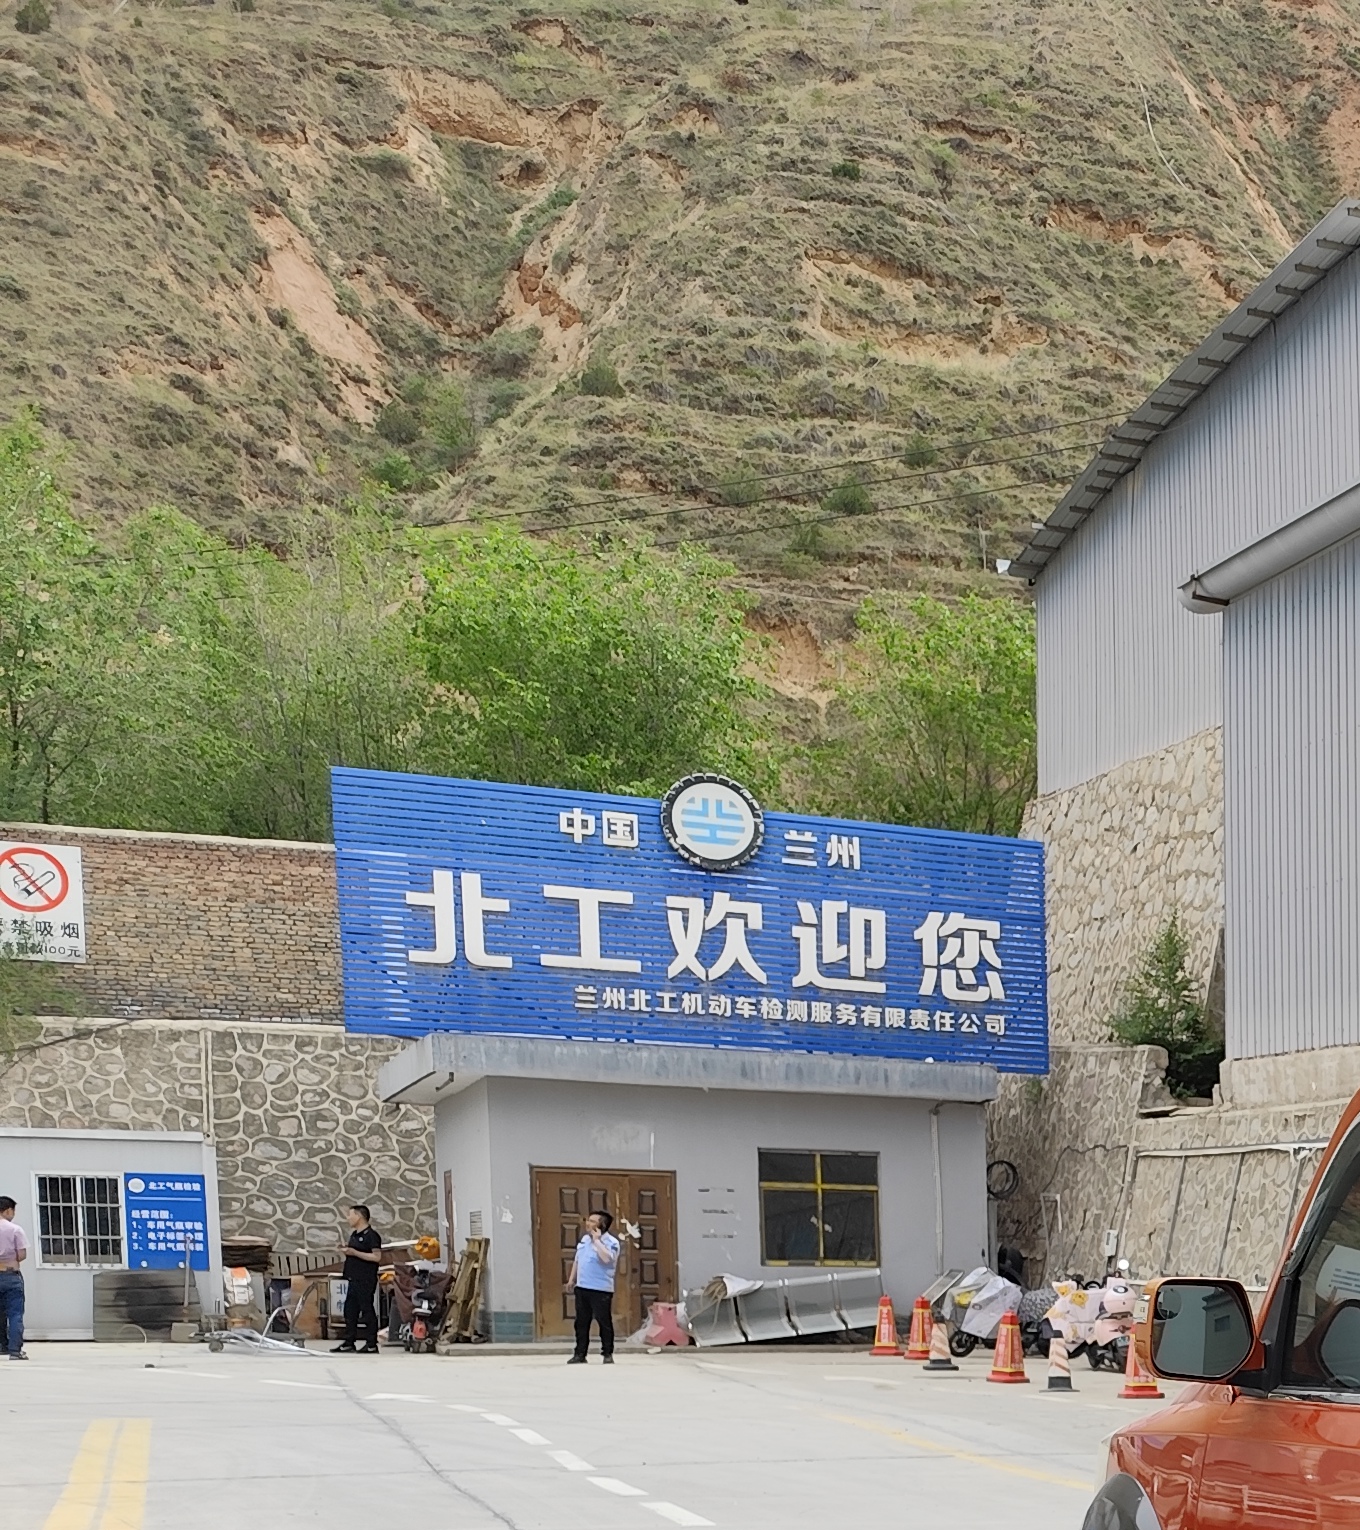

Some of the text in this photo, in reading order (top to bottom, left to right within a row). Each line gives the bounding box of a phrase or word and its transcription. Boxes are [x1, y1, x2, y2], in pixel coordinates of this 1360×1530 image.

[559, 808, 861, 870] 中国 兰州
[0, 918, 79, 939] 禁吸烟
[405, 870, 1005, 1002] 北工欢迎您
[574, 984, 1007, 1036] 兰州北工机动车检测服务有限责任公司
